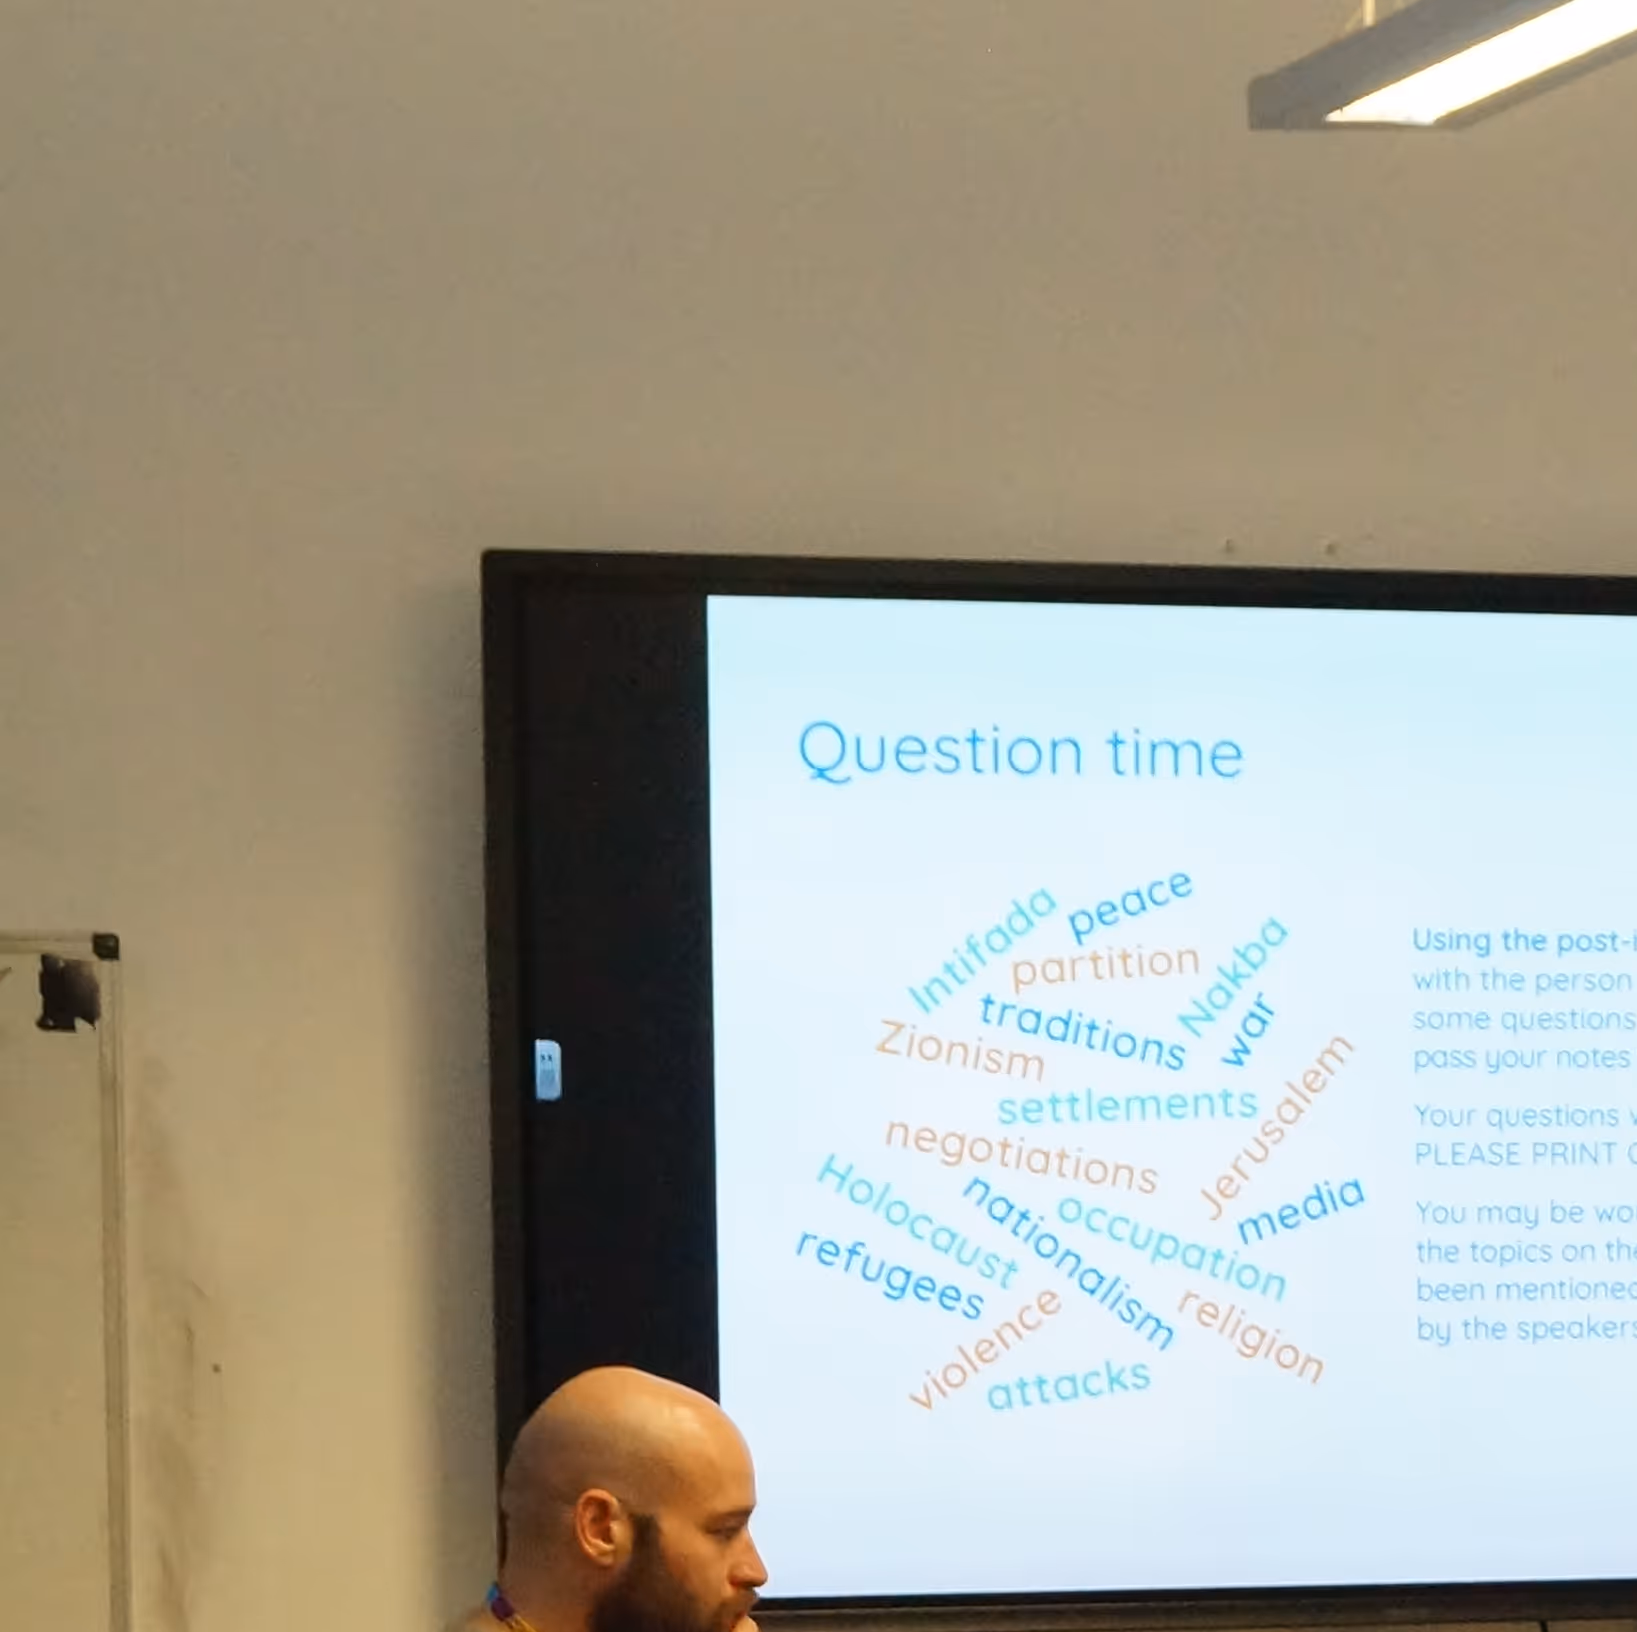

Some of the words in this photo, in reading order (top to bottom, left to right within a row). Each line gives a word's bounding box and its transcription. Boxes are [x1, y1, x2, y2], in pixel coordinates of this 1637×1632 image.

[799, 719, 1082, 786] Question
[1106, 727, 1244, 778] time
[1067, 869, 1194, 945] peace
[908, 885, 1058, 1015] Intifada
[1011, 942, 1200, 994] partition
[1177, 914, 1289, 1038] Nakba
[1412, 927, 1494, 959] Using
[1500, 927, 1549, 953] the
[1412, 966, 1471, 992] with
[1479, 967, 1527, 993] the
[1535, 972, 1633, 997] person
[875, 1018, 1046, 1082] Zionism
[979, 992, 1187, 1071] traditions
[1219, 991, 1280, 1069] war
[1413, 1010, 1493, 1031] some
[1501, 1008, 1637, 1036] questions
[1414, 1049, 1477, 1073] pass
[1485, 1049, 1548, 1075] your
[1556, 1047, 1632, 1071] notes
[997, 1086, 1258, 1125] settlements
[1198, 1031, 1356, 1221] Jerusalem
[1414, 1104, 1477, 1128] Your
[1486, 1104, 1620, 1135] questions
[884, 1117, 1159, 1195] negotiations
[1415, 1142, 1522, 1167] PLEASE
[1532, 1141, 1618, 1166] PRINT
[816, 1152, 1021, 1289] Holocaust
[1237, 1175, 1367, 1245] media
[1416, 1201, 1467, 1225] You
[1477, 1205, 1541, 1231] may
[1550, 1199, 1586, 1224] be
[795, 1230, 987, 1322] refugees
[961, 1173, 1176, 1351] nationalism
[1057, 1194, 1288, 1302] occupation
[1416, 1238, 1460, 1264] the
[1468, 1240, 1553, 1268] topics
[1561, 1243, 1597, 1263] on
[1417, 1276, 1486, 1302] been
[907, 1286, 1064, 1411] violence
[1176, 1286, 1326, 1385] religion
[1417, 1315, 1453, 1347] by
[1461, 1315, 1508, 1341] the
[987, 1357, 1152, 1411] attacks
